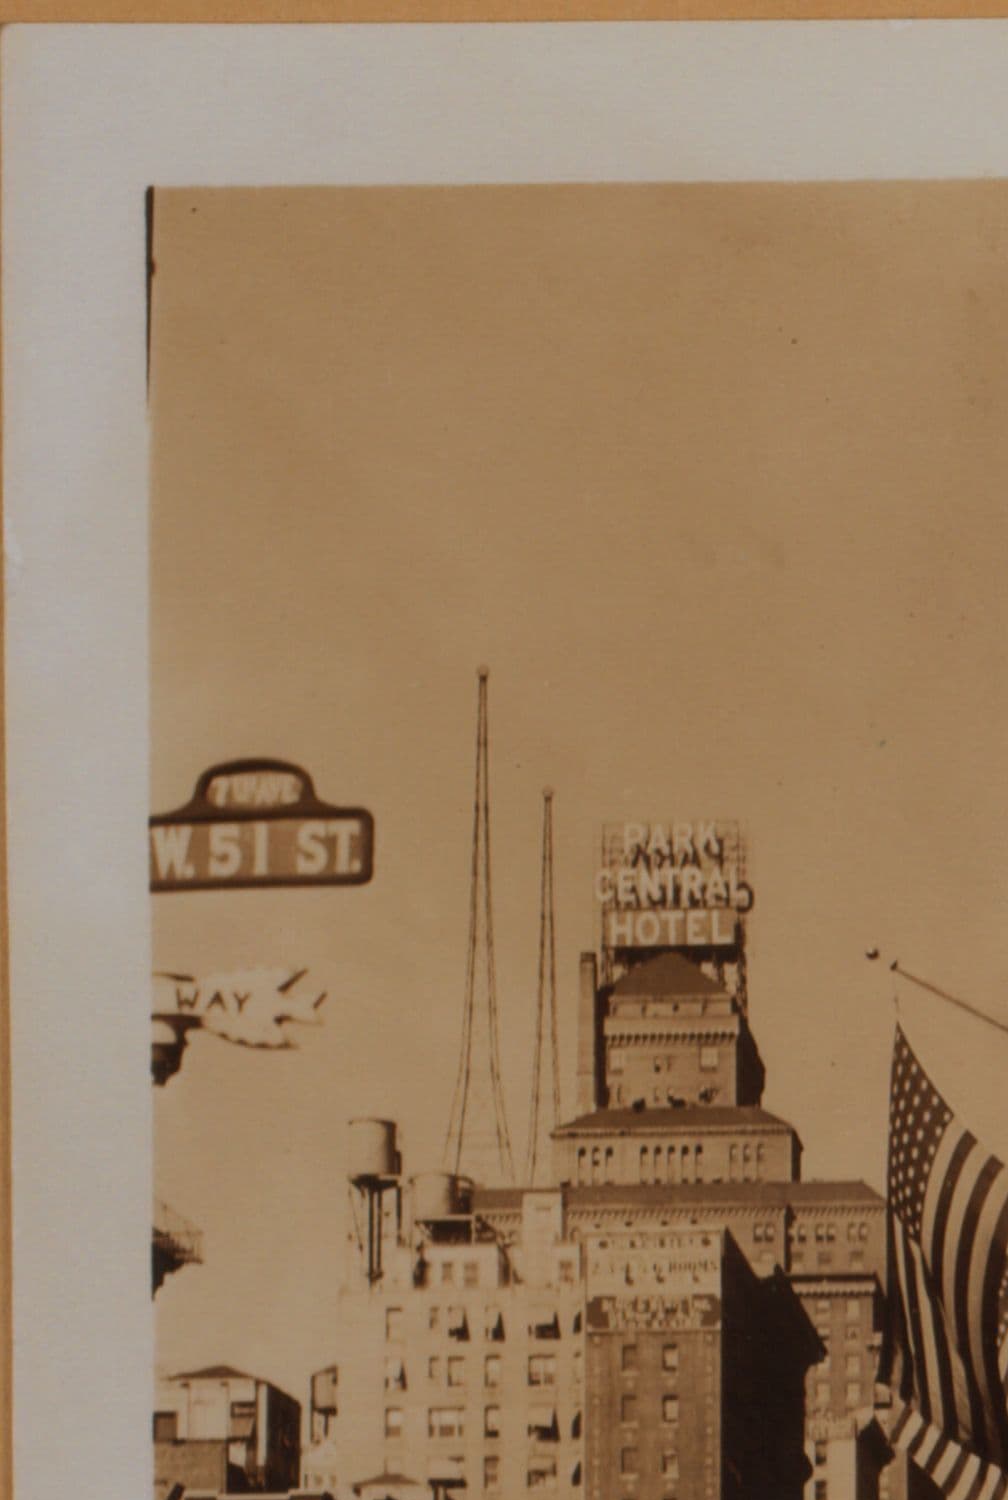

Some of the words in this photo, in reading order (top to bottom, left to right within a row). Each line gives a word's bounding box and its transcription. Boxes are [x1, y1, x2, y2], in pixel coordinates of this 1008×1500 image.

[208, 823, 269, 877] 51
[297, 818, 362, 876] ST.
[623, 821, 720, 861] PARK
[594, 865, 744, 906] CENTRAL
[609, 909, 734, 946] HOTEL
[176, 989, 250, 1014] WAY
